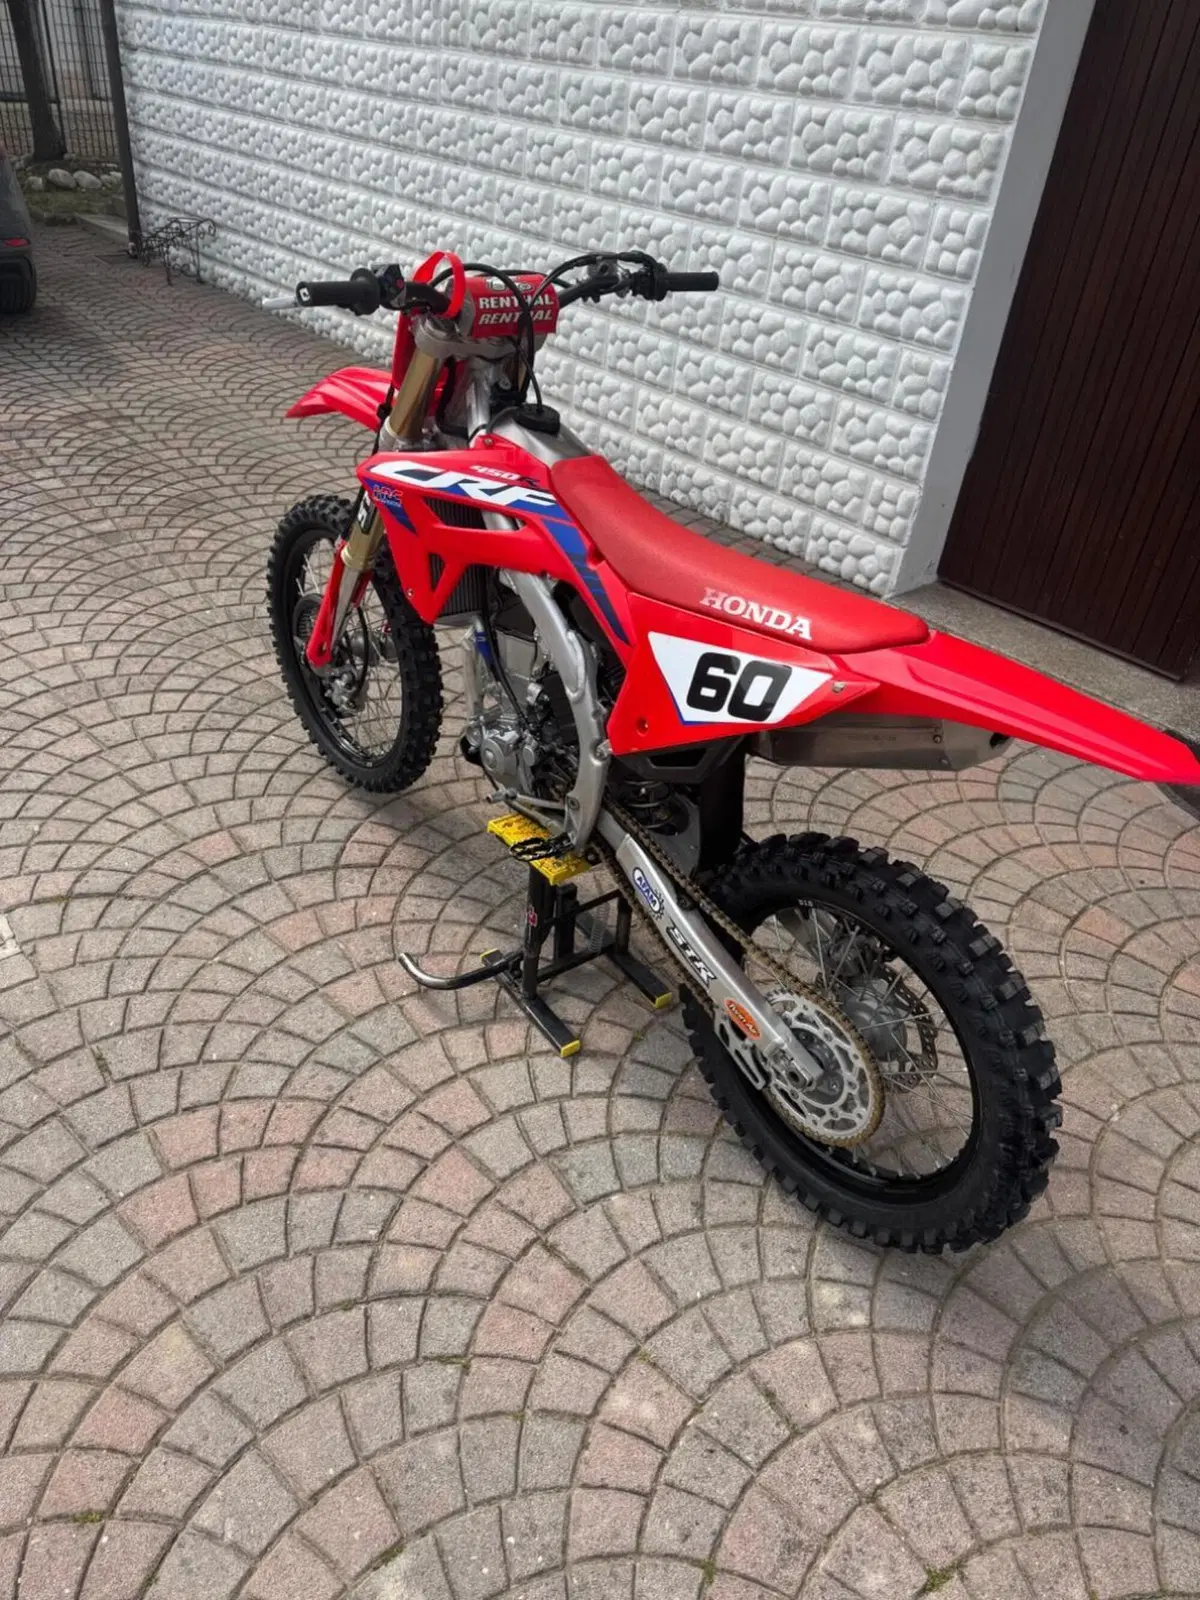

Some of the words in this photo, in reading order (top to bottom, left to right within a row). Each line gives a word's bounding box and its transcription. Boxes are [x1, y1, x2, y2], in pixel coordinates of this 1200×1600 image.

[479, 310, 553, 325] RENTAL
[369, 461, 557, 506] CRF
[699, 587, 813, 640] HONDA
[686, 652, 792, 722] 60
